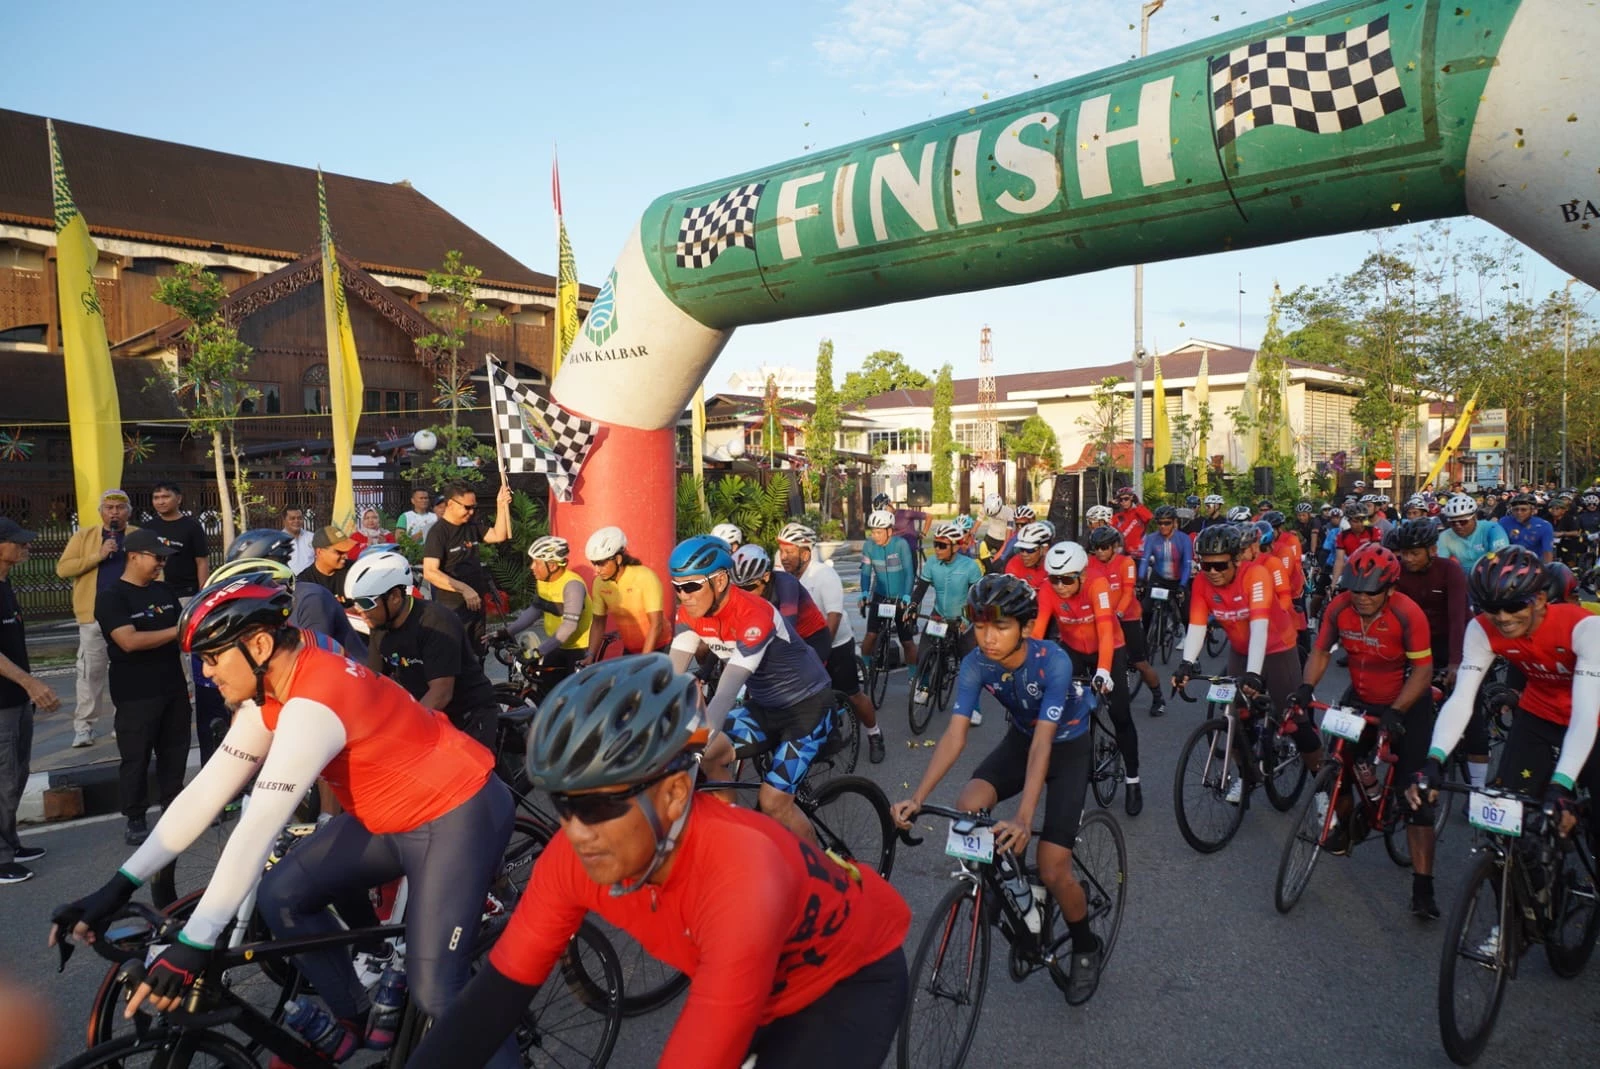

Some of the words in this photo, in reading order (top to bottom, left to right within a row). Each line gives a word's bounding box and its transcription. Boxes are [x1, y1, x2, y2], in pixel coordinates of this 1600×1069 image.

[776, 75, 1176, 260] FINISH
[569, 351, 592, 365] BANK
[595, 345, 649, 362] KALBAR
[220, 743, 262, 764] PALESTINE
[255, 780, 297, 793] PALESTINE
[1482, 806, 1506, 823] 067
